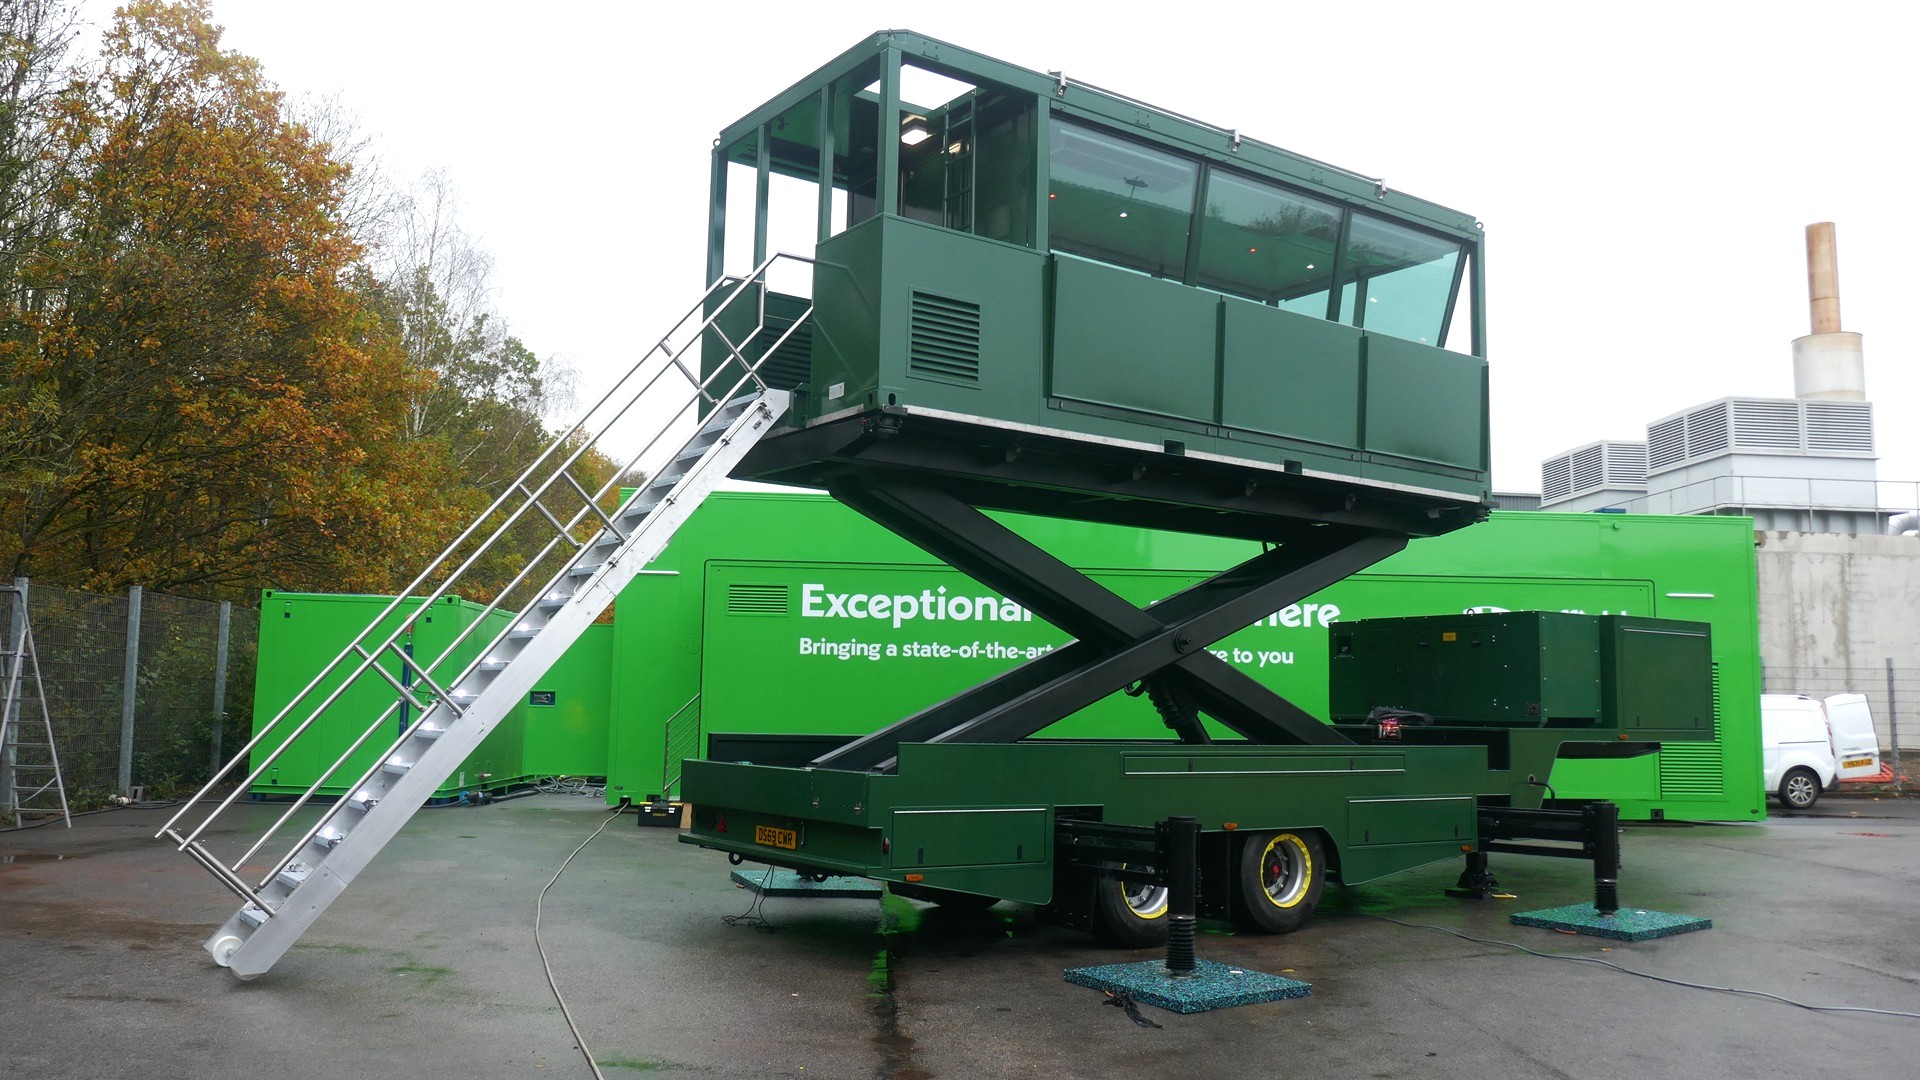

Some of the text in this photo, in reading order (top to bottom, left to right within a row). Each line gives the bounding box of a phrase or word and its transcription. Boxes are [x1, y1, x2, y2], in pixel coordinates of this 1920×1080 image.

[799, 637, 882, 661] Bringing
[885, 643, 898, 657] a
[1232, 647, 1254, 664] to
[1257, 651, 1294, 668] you
[758, 827, 777, 843] DS69
